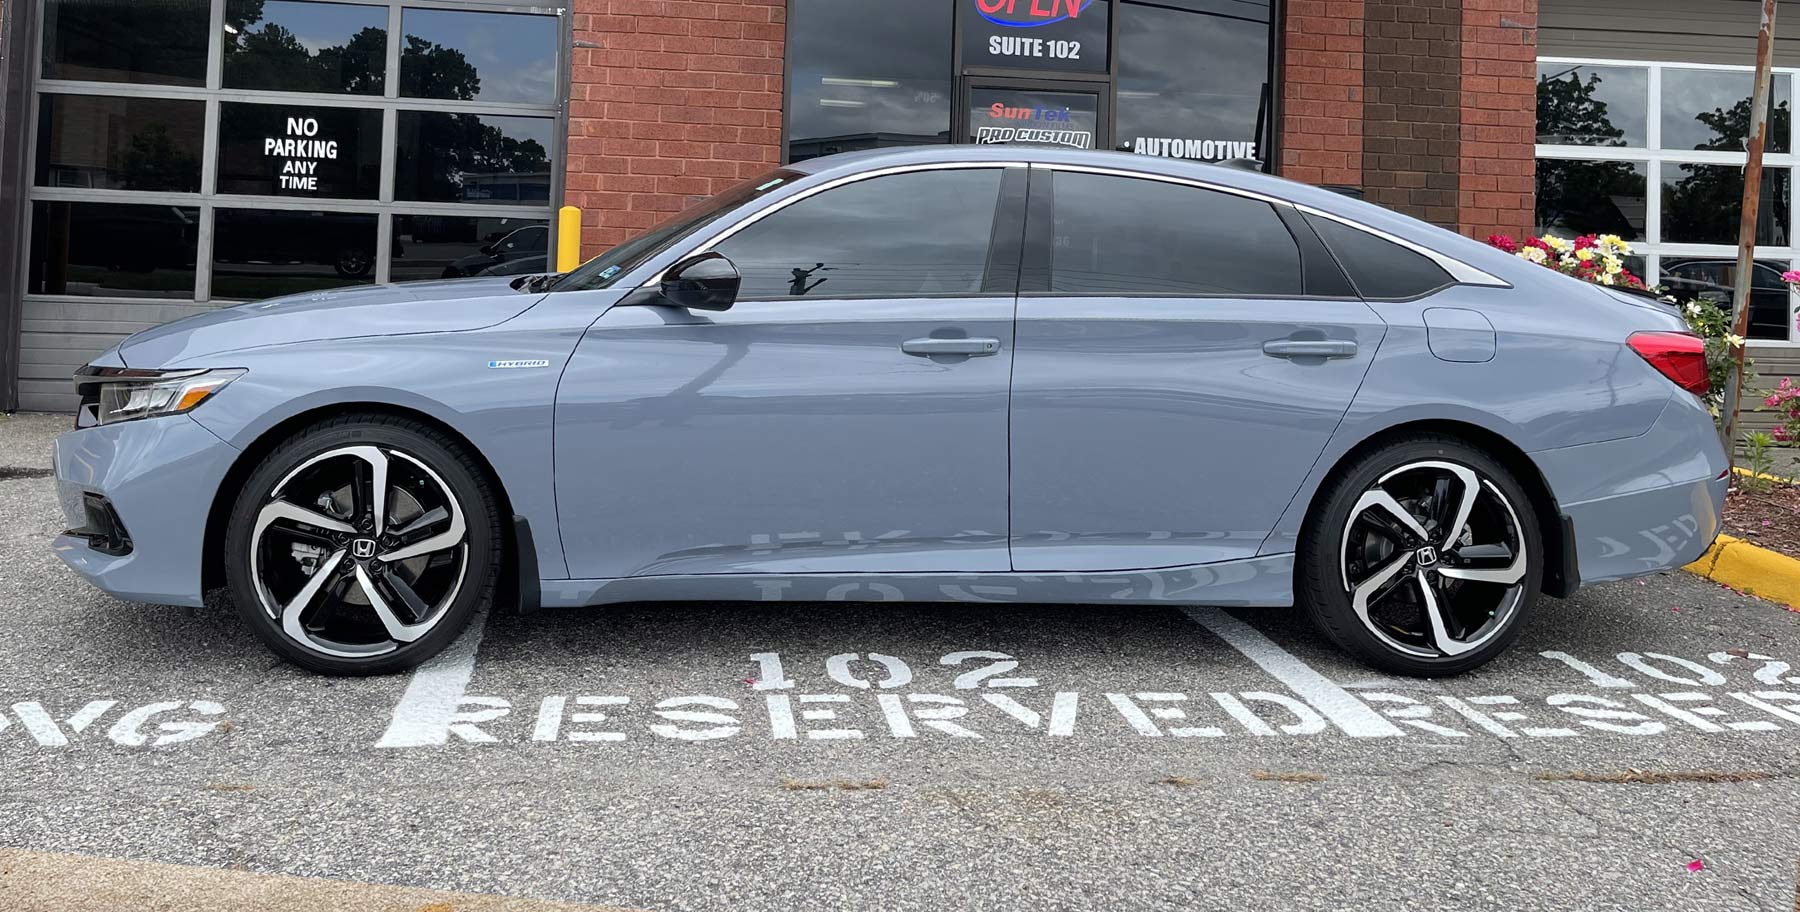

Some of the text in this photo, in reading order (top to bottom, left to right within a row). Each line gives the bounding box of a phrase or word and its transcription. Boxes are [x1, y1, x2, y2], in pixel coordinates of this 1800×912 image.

[989, 35, 1081, 59] SUITE 102
[988, 102, 1070, 122] SunTek
[286, 117, 319, 137] NO
[976, 127, 1091, 149] PRO CUSTOM
[264, 137, 338, 159] PARKING
[1134, 137, 1256, 160] AUTOMOTIVE
[282, 160, 318, 175] ANY
[279, 175, 318, 190] TIME
[750, 650, 1039, 690] 102
[440, 689, 1326, 744] RESERVED
